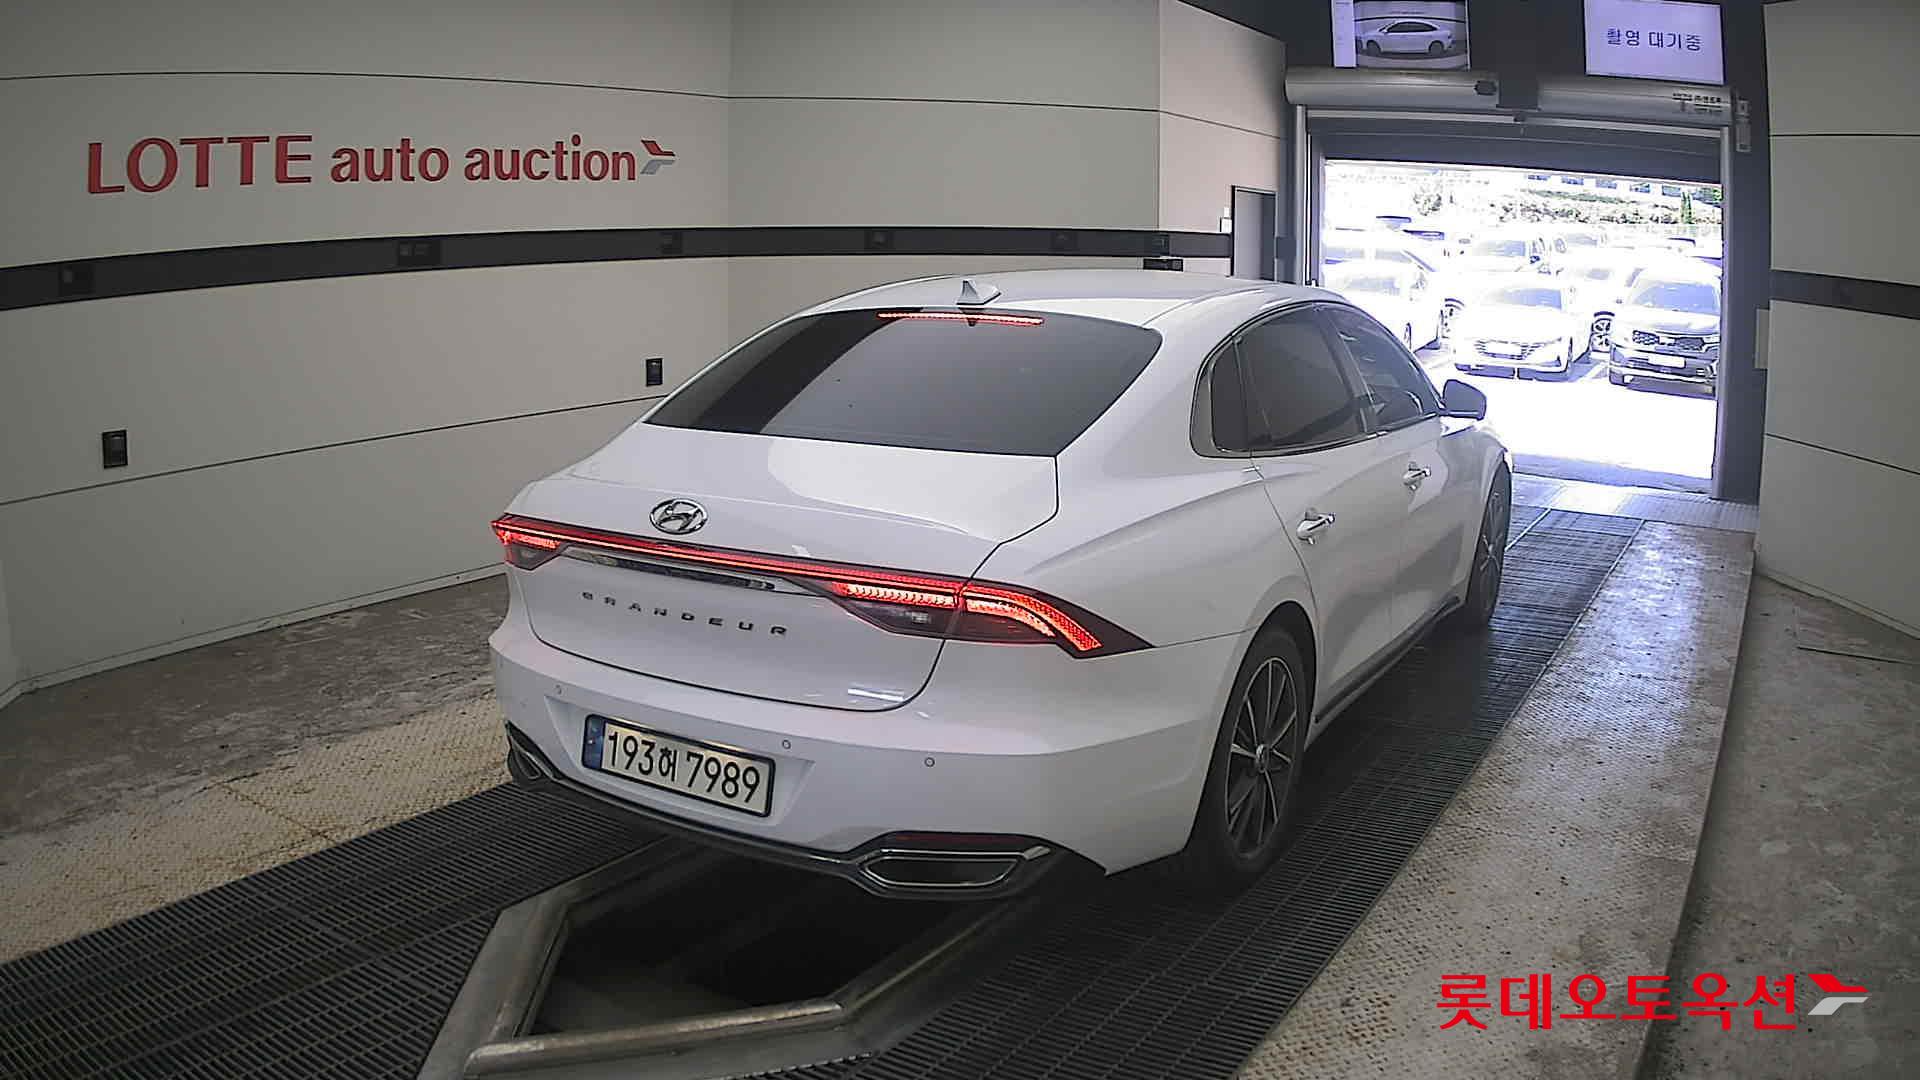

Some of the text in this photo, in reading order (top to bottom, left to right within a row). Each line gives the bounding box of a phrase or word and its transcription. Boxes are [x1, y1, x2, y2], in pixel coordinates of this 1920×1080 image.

[1648, 31, 1702, 52] 대기중
[87, 133, 637, 195] LOTTE auto auction
[581, 591, 788, 637] GRANDEUR
[607, 730, 761, 804] 193허 7989
